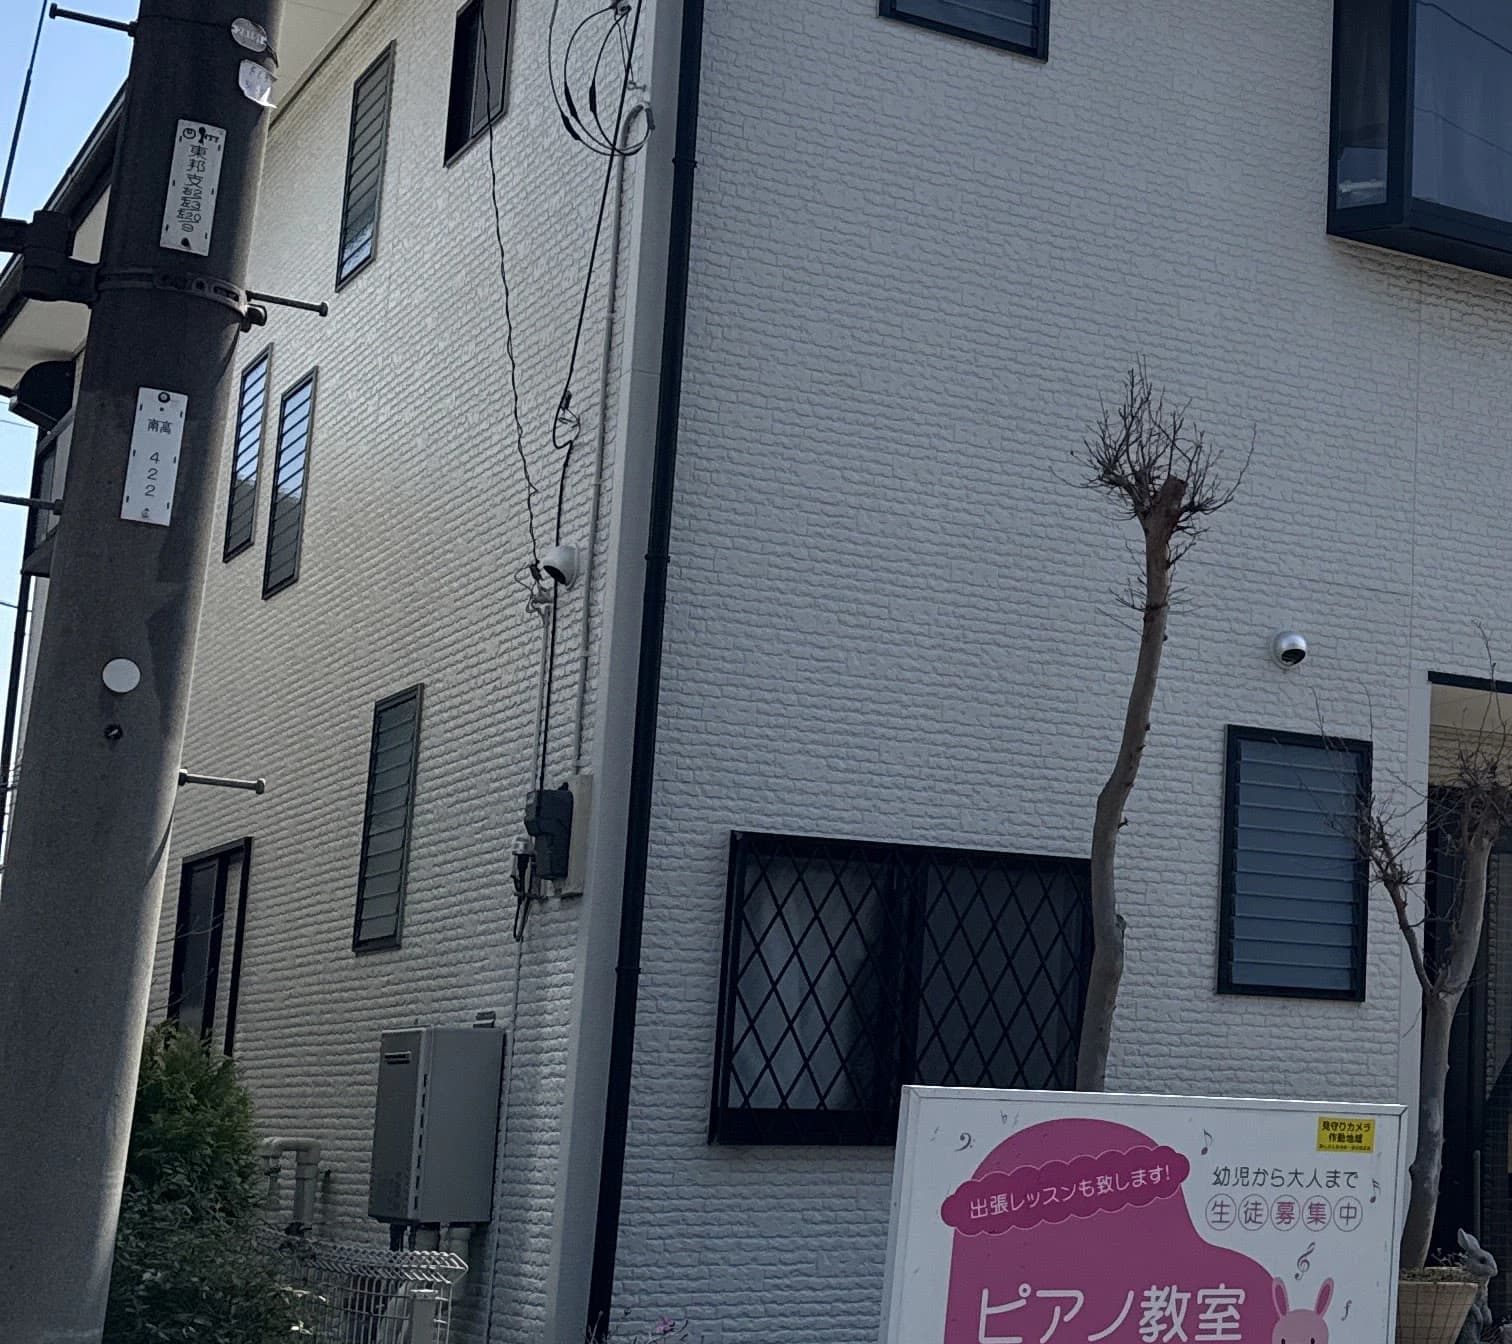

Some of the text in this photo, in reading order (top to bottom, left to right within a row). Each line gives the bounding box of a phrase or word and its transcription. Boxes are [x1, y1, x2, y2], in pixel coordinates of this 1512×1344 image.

[144, 452, 160, 497] 422
[1211, 1165, 1359, 1189] 幼児から大人まで
[1209, 1199, 1359, 1226] 生徒募集中
[978, 1282, 1246, 1344] ピアノ教室
